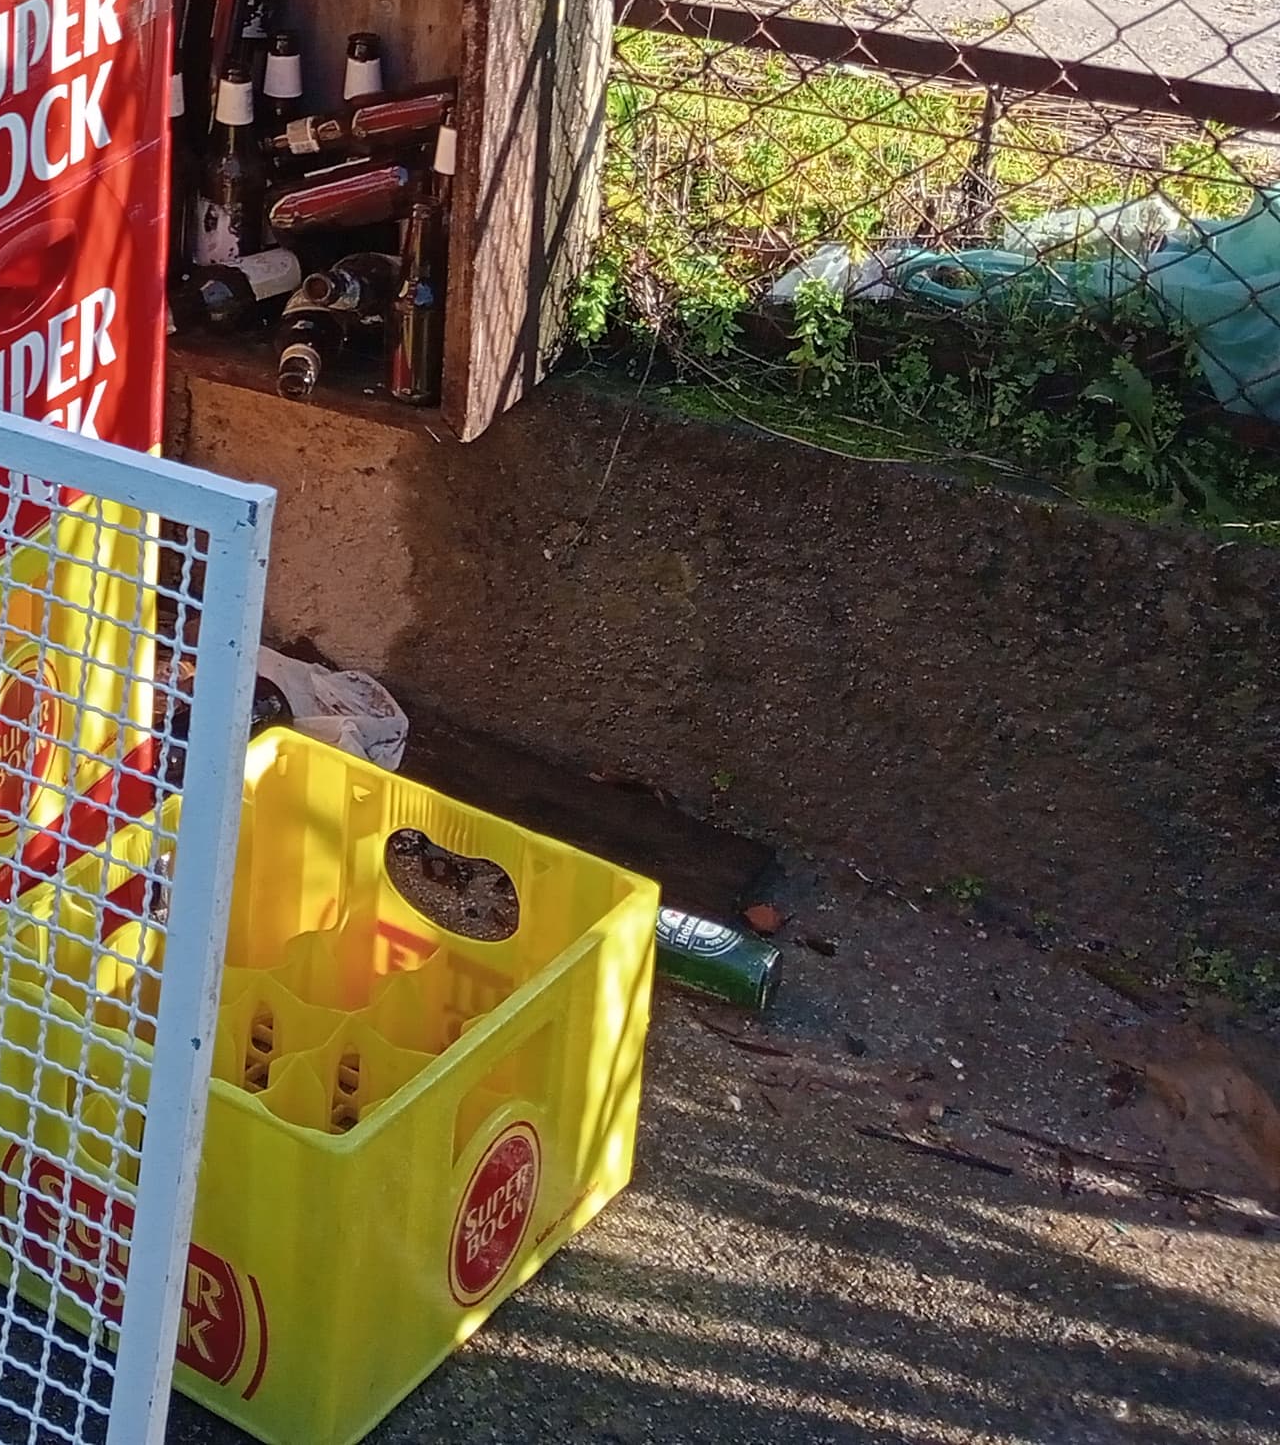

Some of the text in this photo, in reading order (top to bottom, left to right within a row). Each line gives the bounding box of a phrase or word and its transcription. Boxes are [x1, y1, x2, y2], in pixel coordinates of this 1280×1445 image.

[465, 1163, 533, 1240] SUPER
[466, 1197, 524, 1264] BOCK
[47, 1229, 215, 1363] BOK
